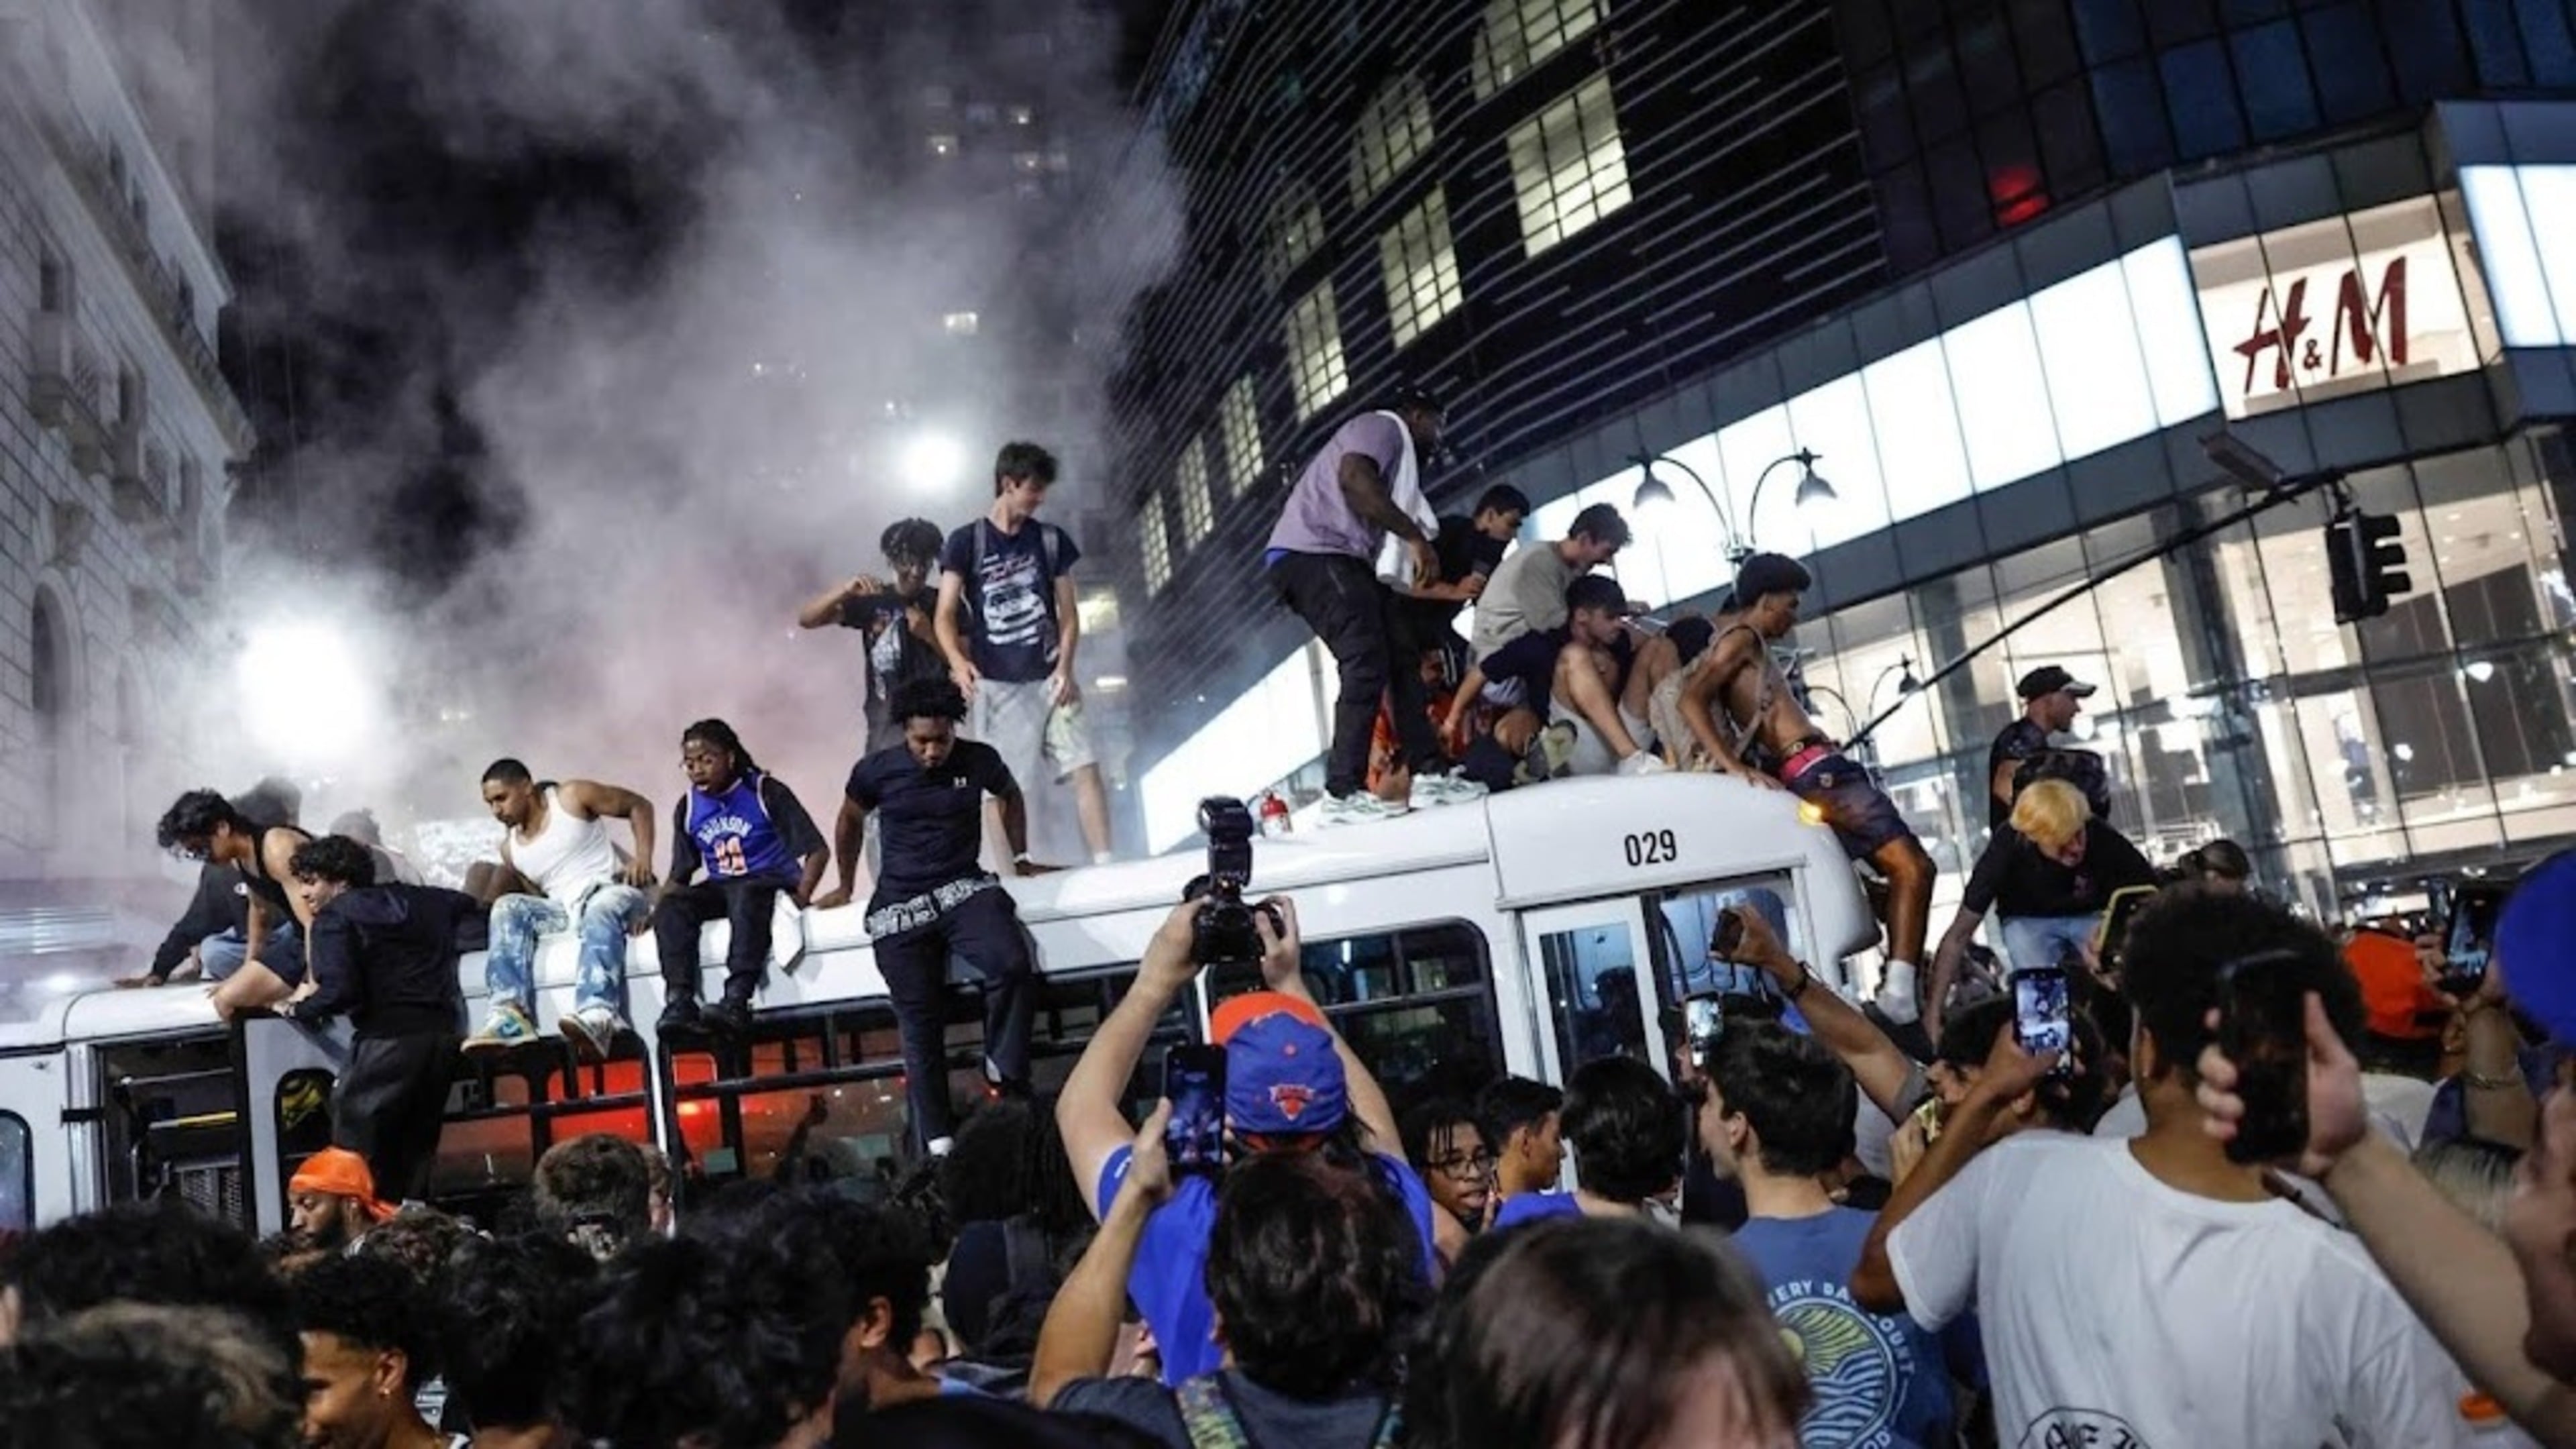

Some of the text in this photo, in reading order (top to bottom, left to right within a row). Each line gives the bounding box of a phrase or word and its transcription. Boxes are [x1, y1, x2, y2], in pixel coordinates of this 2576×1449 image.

[2233, 256, 2407, 394] H&M
[1624, 829, 1677, 867] 029
[1823, 1281, 1858, 1306] DA
[1868, 1313, 1915, 1375] OUNT
